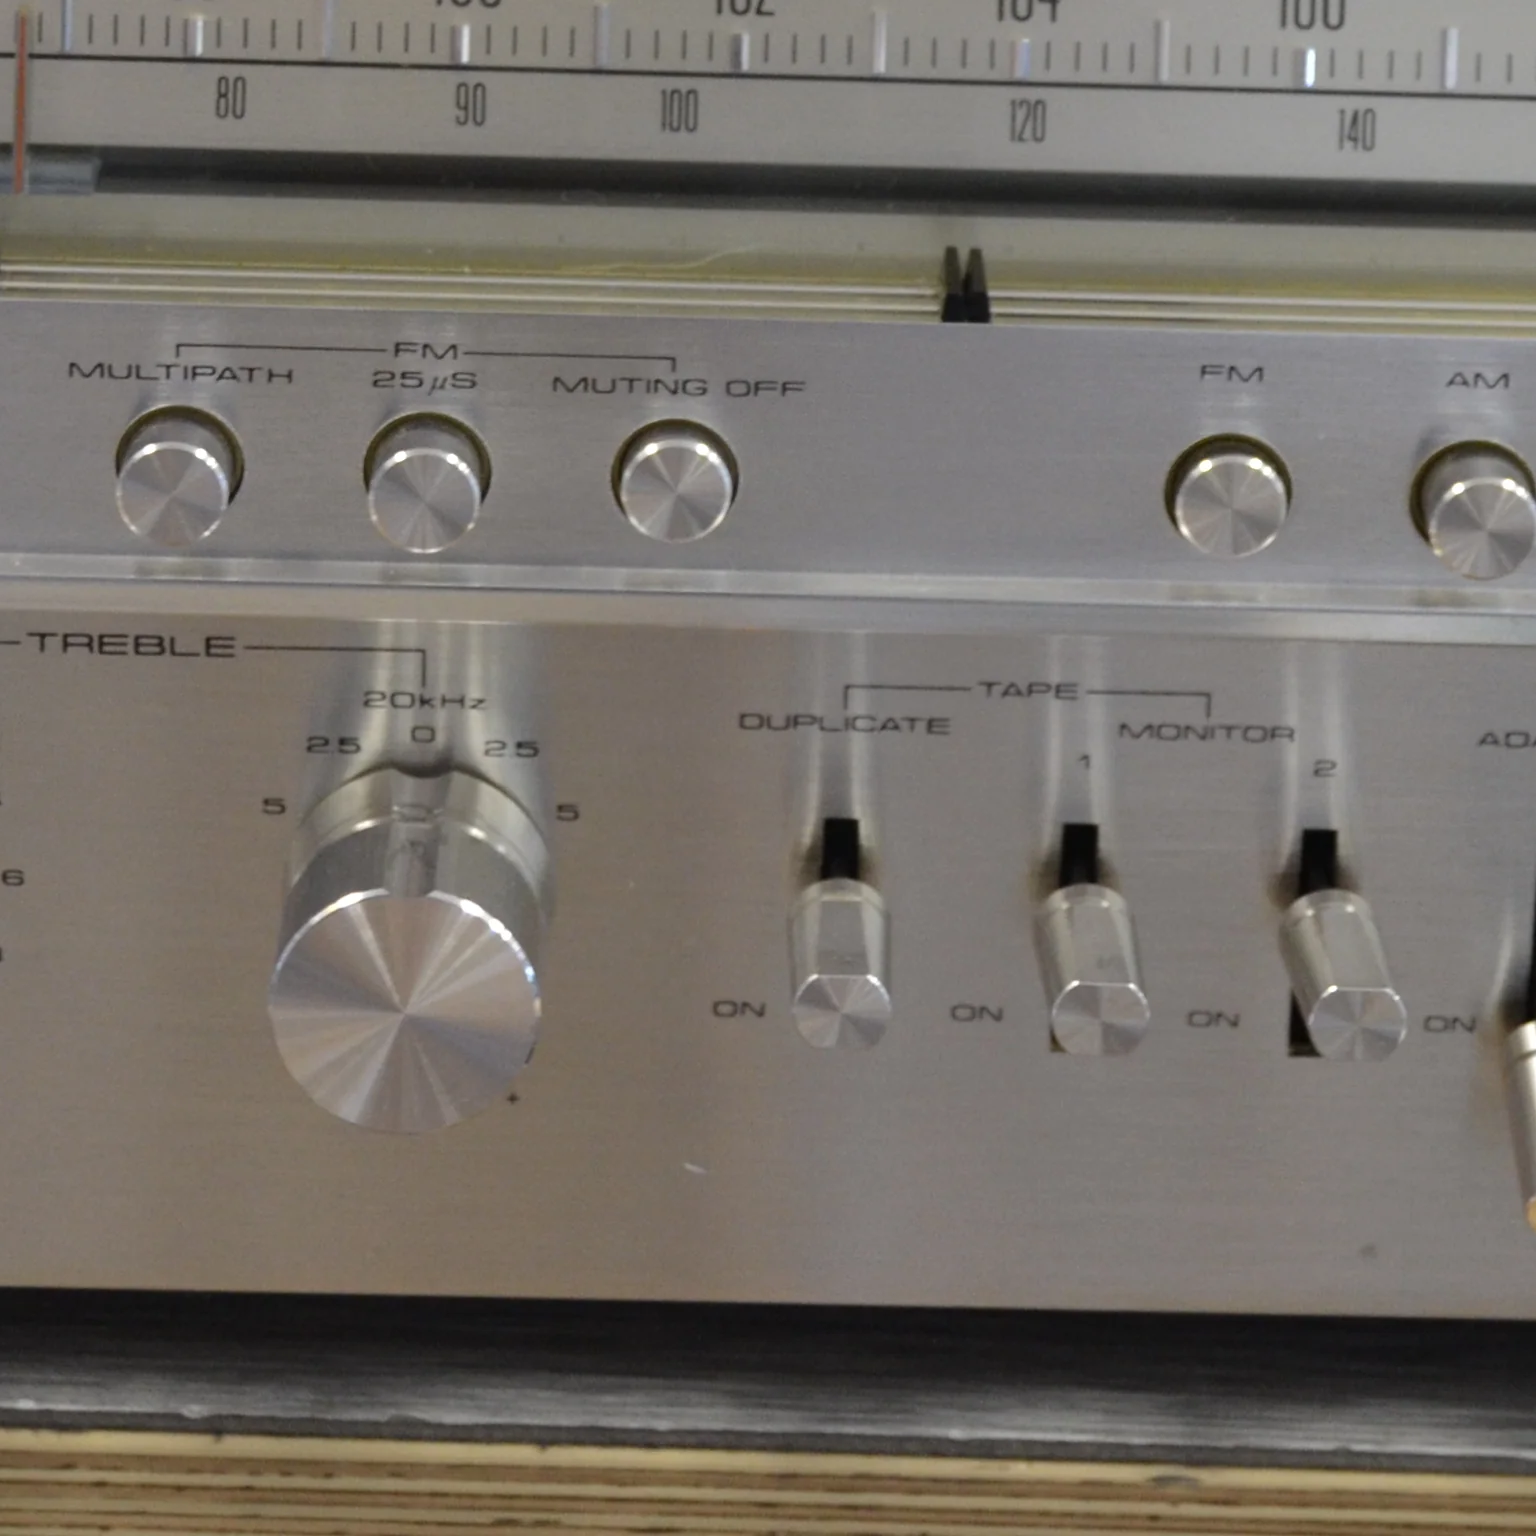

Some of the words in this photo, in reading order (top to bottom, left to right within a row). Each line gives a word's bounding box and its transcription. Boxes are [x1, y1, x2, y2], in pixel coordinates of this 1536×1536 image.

[215, 75, 246, 120] 80
[455, 83, 486, 126] 90
[661, 89, 698, 132] 100
[1010, 99, 1046, 143] 120
[1338, 109, 1375, 152] 140
[393, 343, 459, 359] FM
[68, 362, 294, 384] MULTIPATH
[552, 375, 708, 397] MUTING
[725, 379, 807, 398] OFF
[1199, 365, 1264, 383] FM
[1445, 372, 1510, 389] AM
[26, 631, 237, 659] TREBLE
[363, 690, 488, 711] 20kHz
[977, 681, 1079, 701] TAPE
[739, 712, 950, 736] DUPLICATE
[1118, 721, 1296, 744] MONITOR
[262, 797, 287, 816] 5
[410, 725, 436, 745] 0
[556, 803, 581, 823] 5
[1078, 754, 1092, 770] 1
[1313, 759, 1337, 778] 2
[1, 870, 26, 887] 6
[712, 1000, 766, 1020] ON
[950, 1003, 1004, 1024] ON
[1186, 1009, 1240, 1030] ON
[1423, 1014, 1477, 1034] ON
